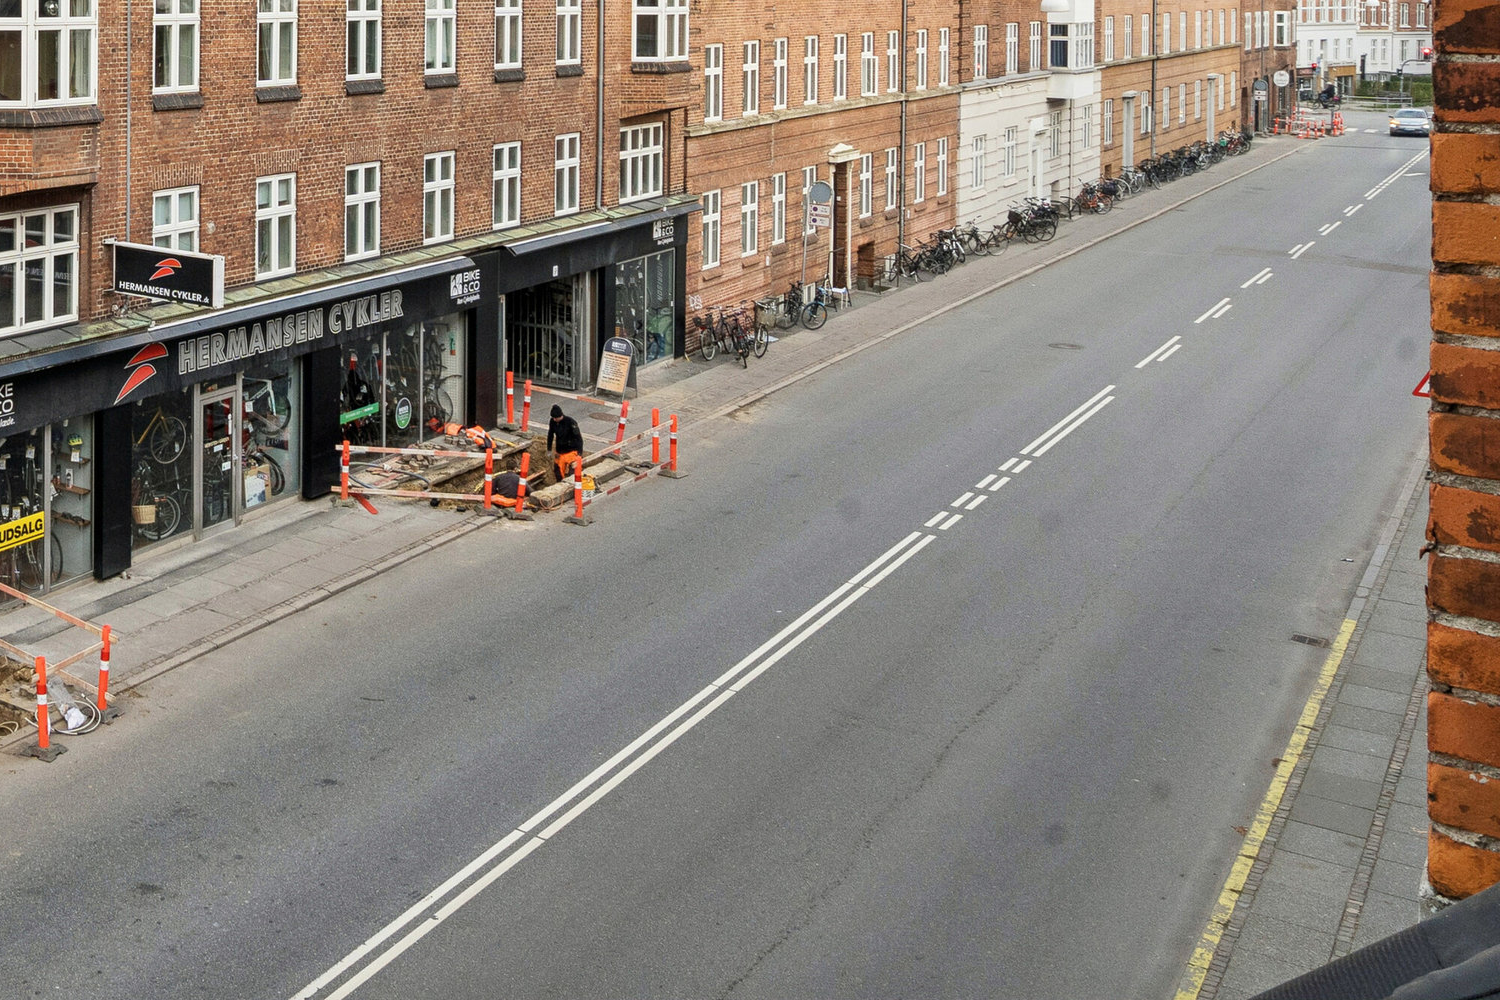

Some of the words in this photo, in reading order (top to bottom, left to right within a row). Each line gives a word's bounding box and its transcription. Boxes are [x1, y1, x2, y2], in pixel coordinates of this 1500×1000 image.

[463, 269, 480, 282] BIKE
[119, 281, 170, 297] HERMANSEN
[171, 290, 202, 302] CYKLER
[469, 281, 480, 292] CO
[178, 307, 323, 375] HERMANSEN
[329, 289, 404, 334] CYKLER
